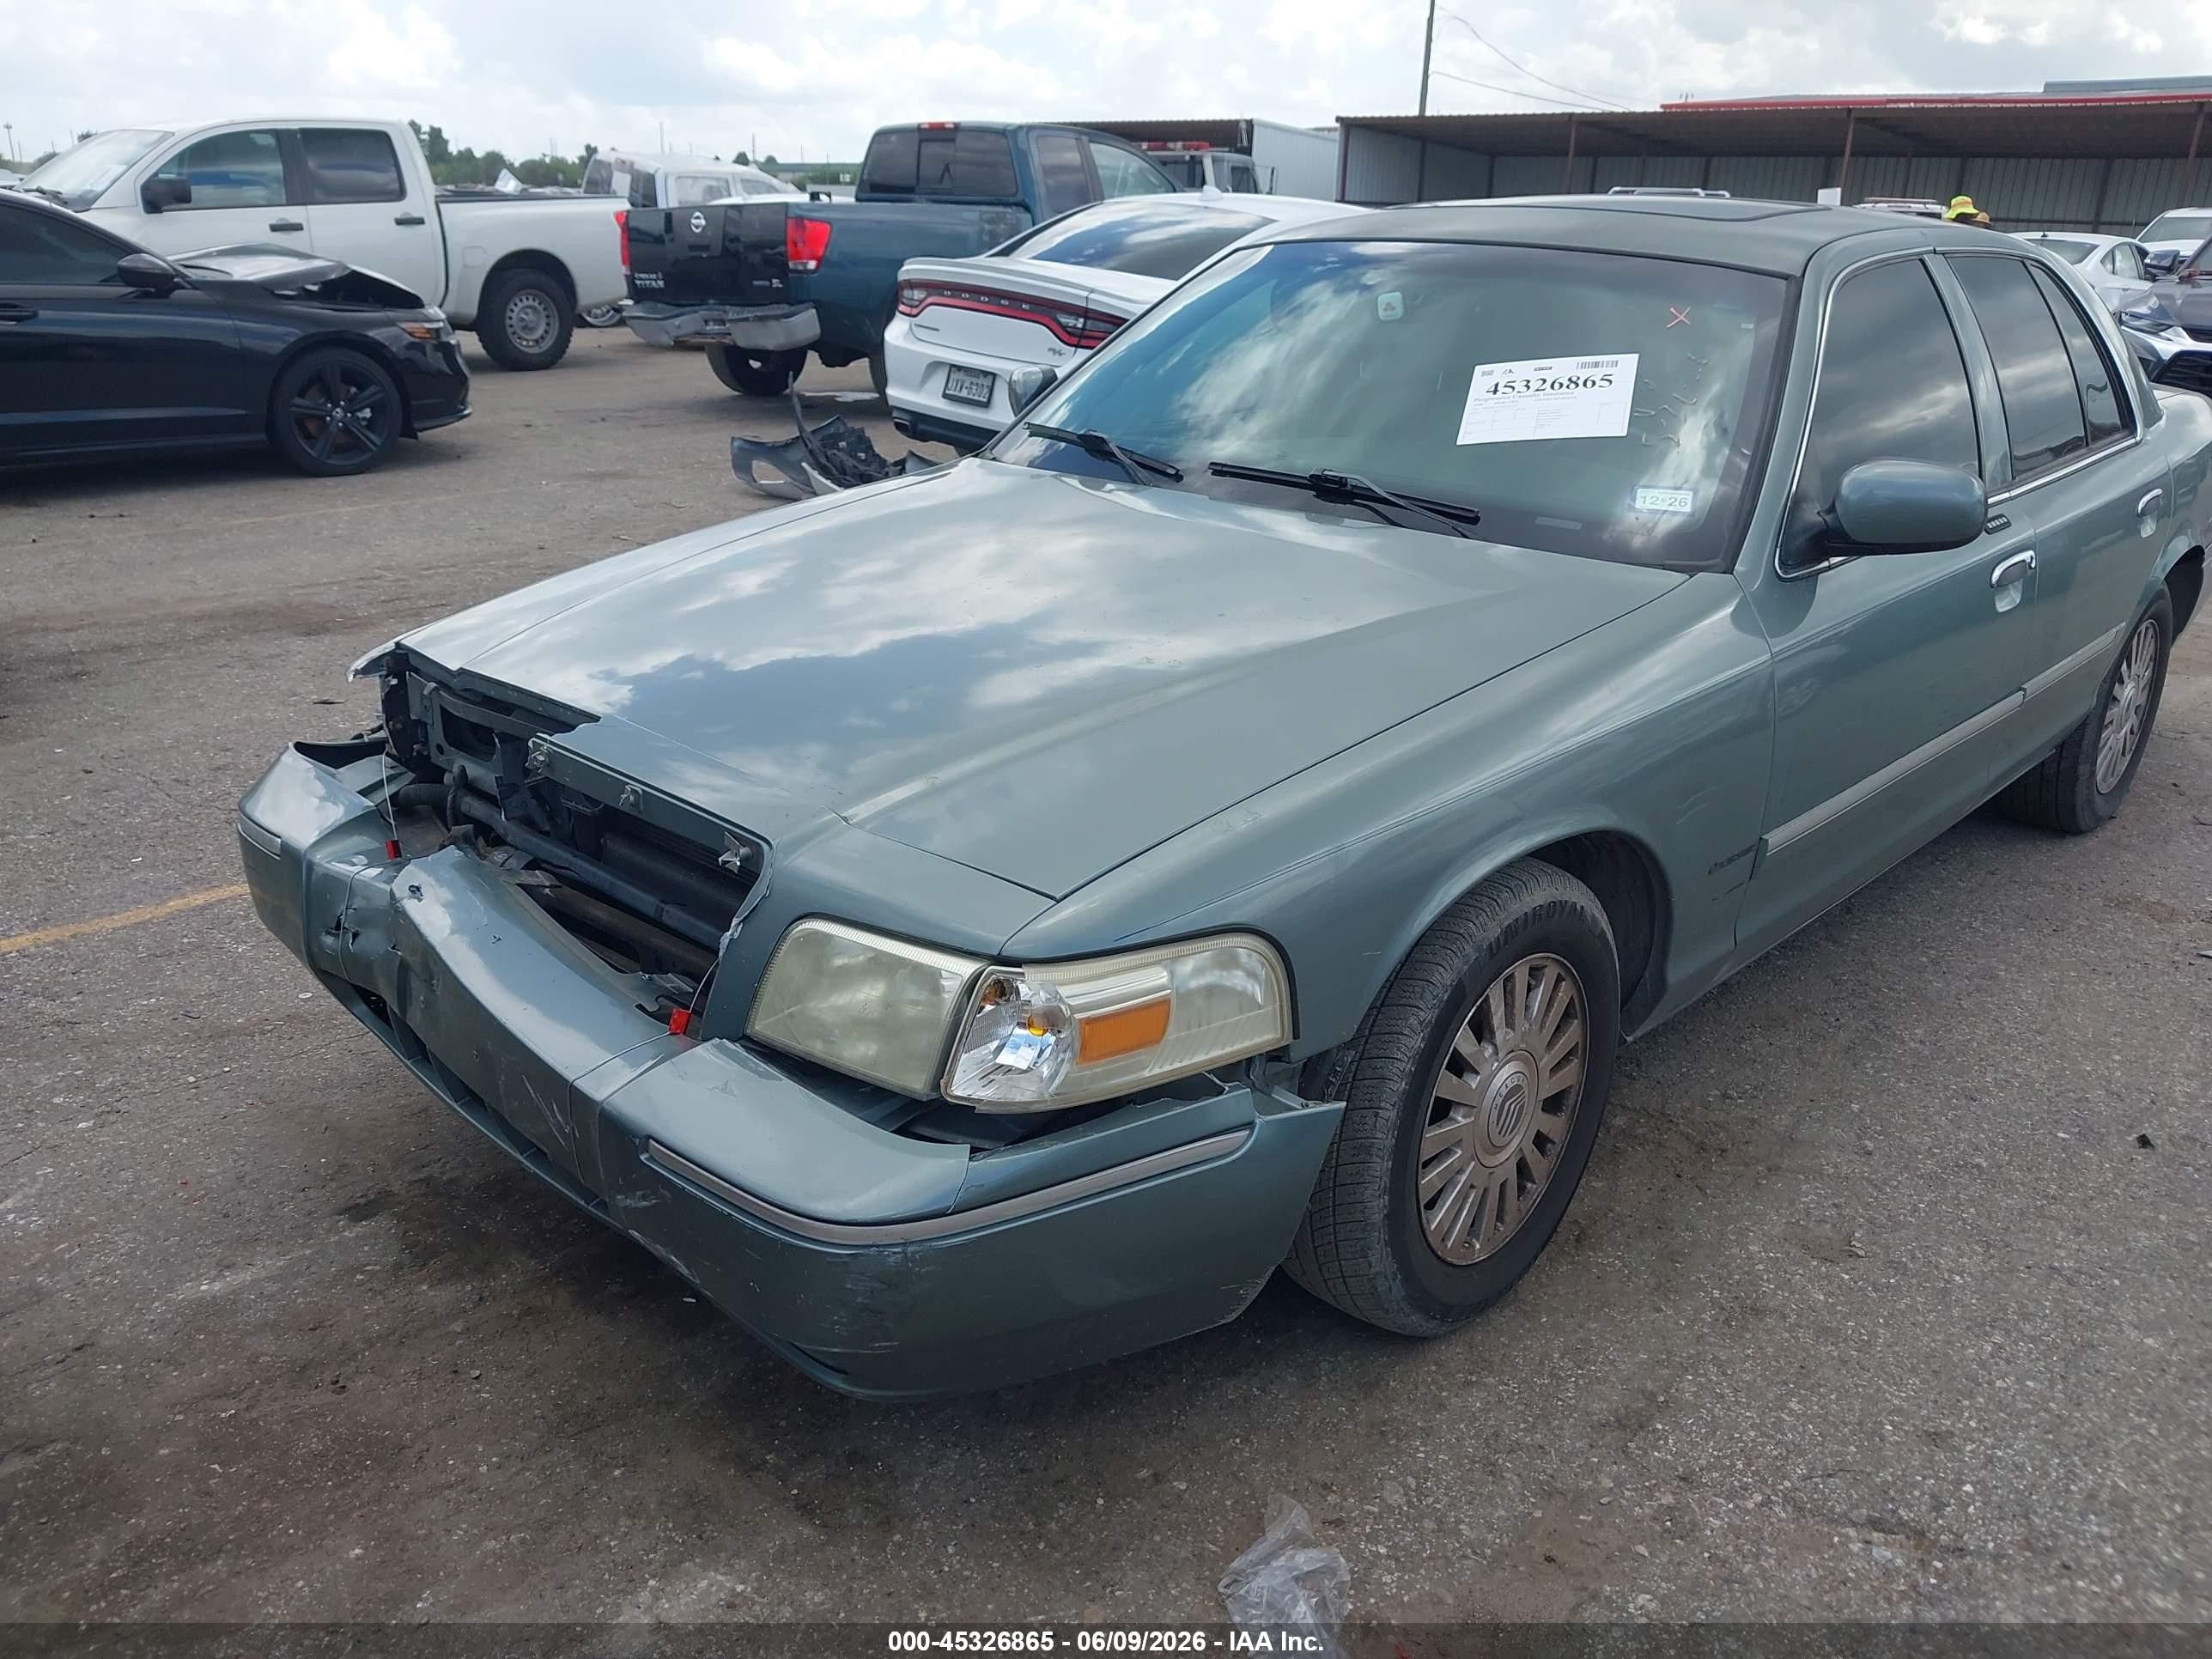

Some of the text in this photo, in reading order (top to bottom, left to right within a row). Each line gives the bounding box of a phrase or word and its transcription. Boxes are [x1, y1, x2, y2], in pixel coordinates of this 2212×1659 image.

[635, 279, 665, 289] TITAN
[943, 290, 1030, 310] DODGE
[1485, 374, 1614, 396] 45326865
